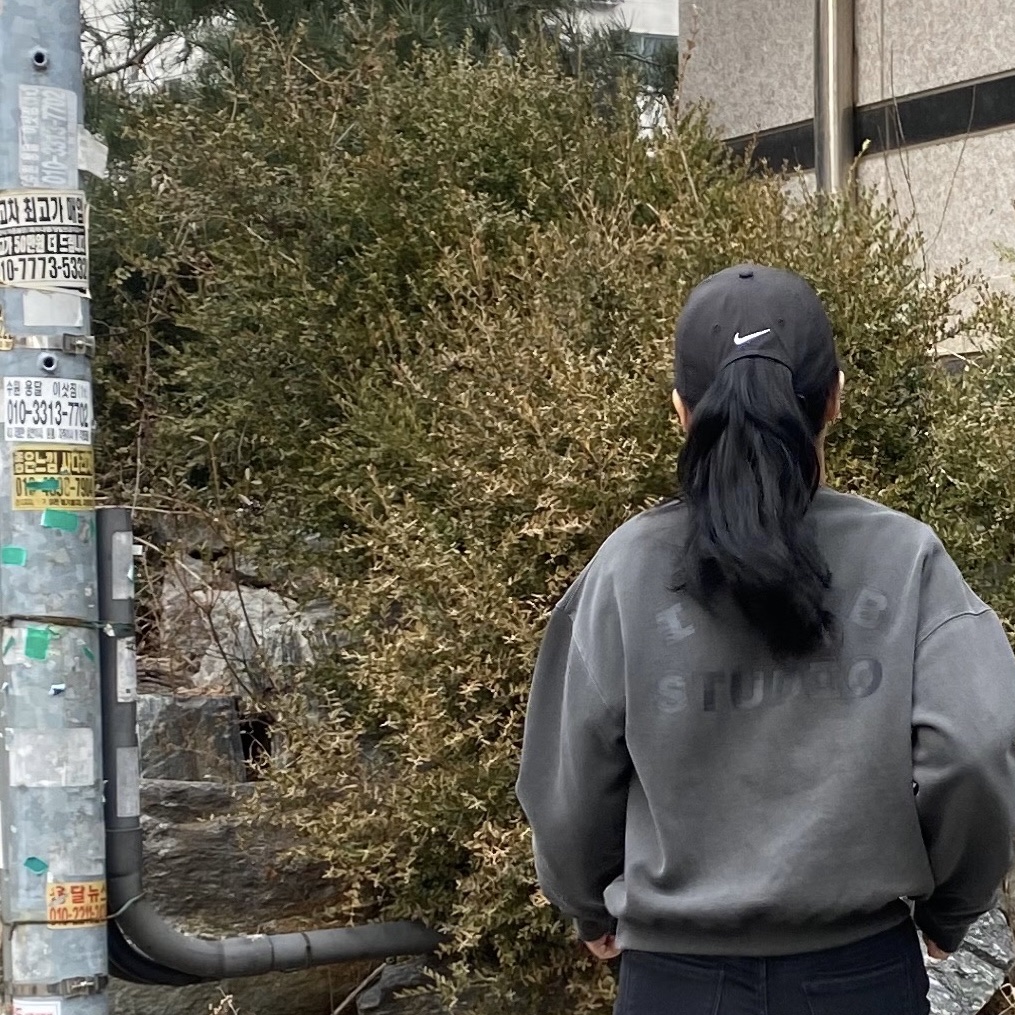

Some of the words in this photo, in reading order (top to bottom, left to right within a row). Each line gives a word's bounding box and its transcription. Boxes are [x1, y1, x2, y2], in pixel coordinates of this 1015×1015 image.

[23, 197, 63, 223] 최고가
[7, 380, 21, 396] 수원
[25, 380, 43, 397] 용달
[7, 399, 89, 428] 010-3313-7702
